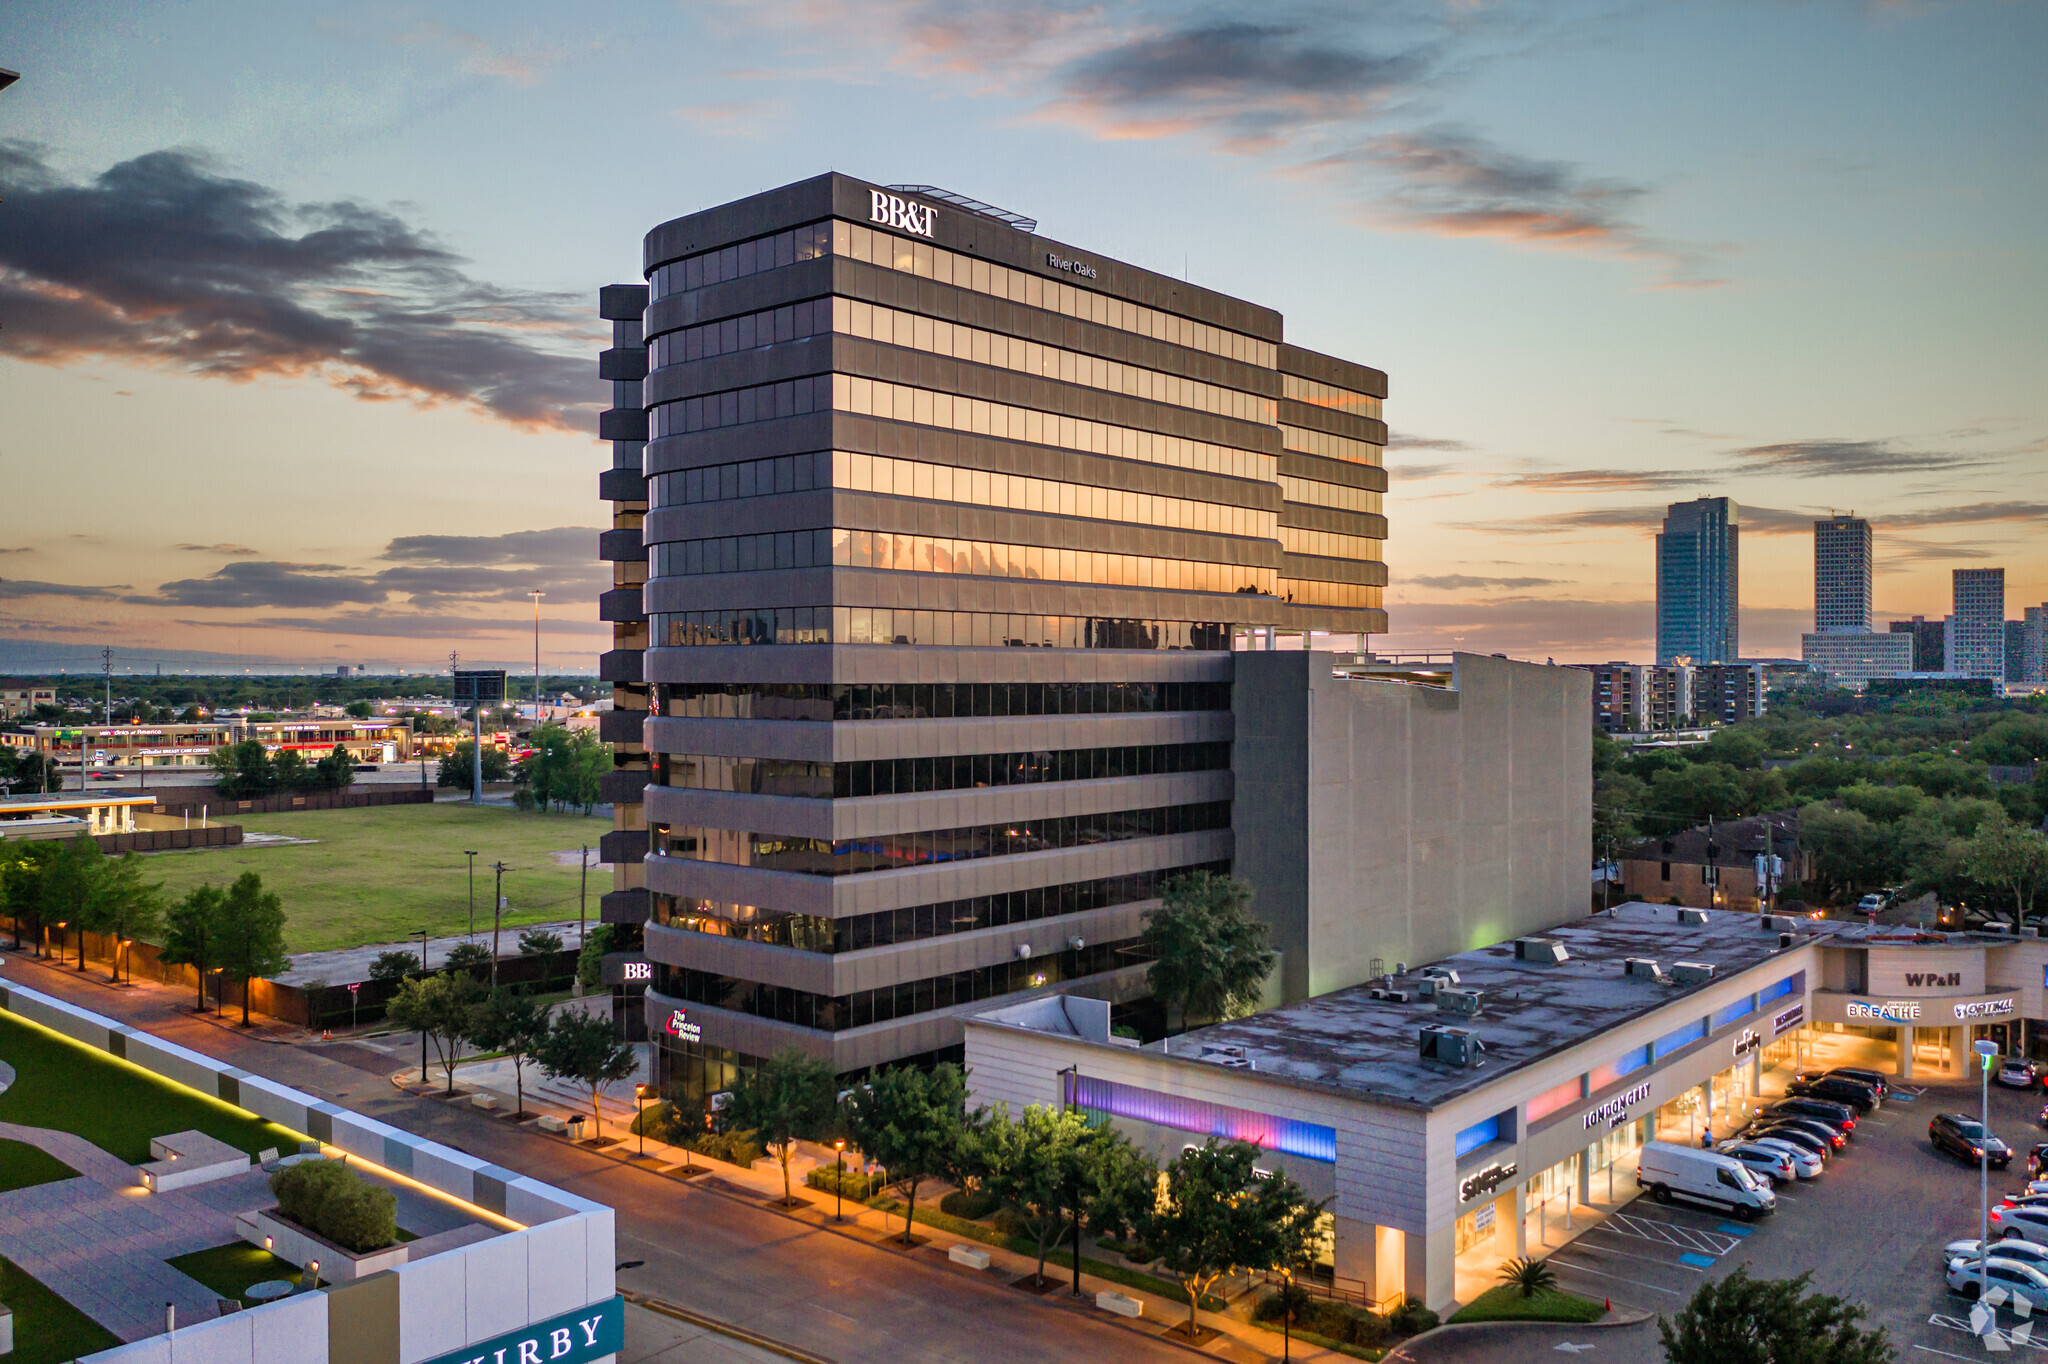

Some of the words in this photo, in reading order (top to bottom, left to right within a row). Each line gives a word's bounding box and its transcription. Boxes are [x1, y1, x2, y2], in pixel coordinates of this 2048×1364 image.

[869, 189, 938, 239] BB&T
[1049, 253, 1072, 271] River
[1074, 261, 1097, 278] Oaks
[673, 1010, 686, 1021] The
[1847, 1003, 1921, 1019] BREATHE
[672, 1019, 701, 1033] Princeton
[678, 1029, 701, 1043] Review
[459, 1314, 603, 1364] RBY
